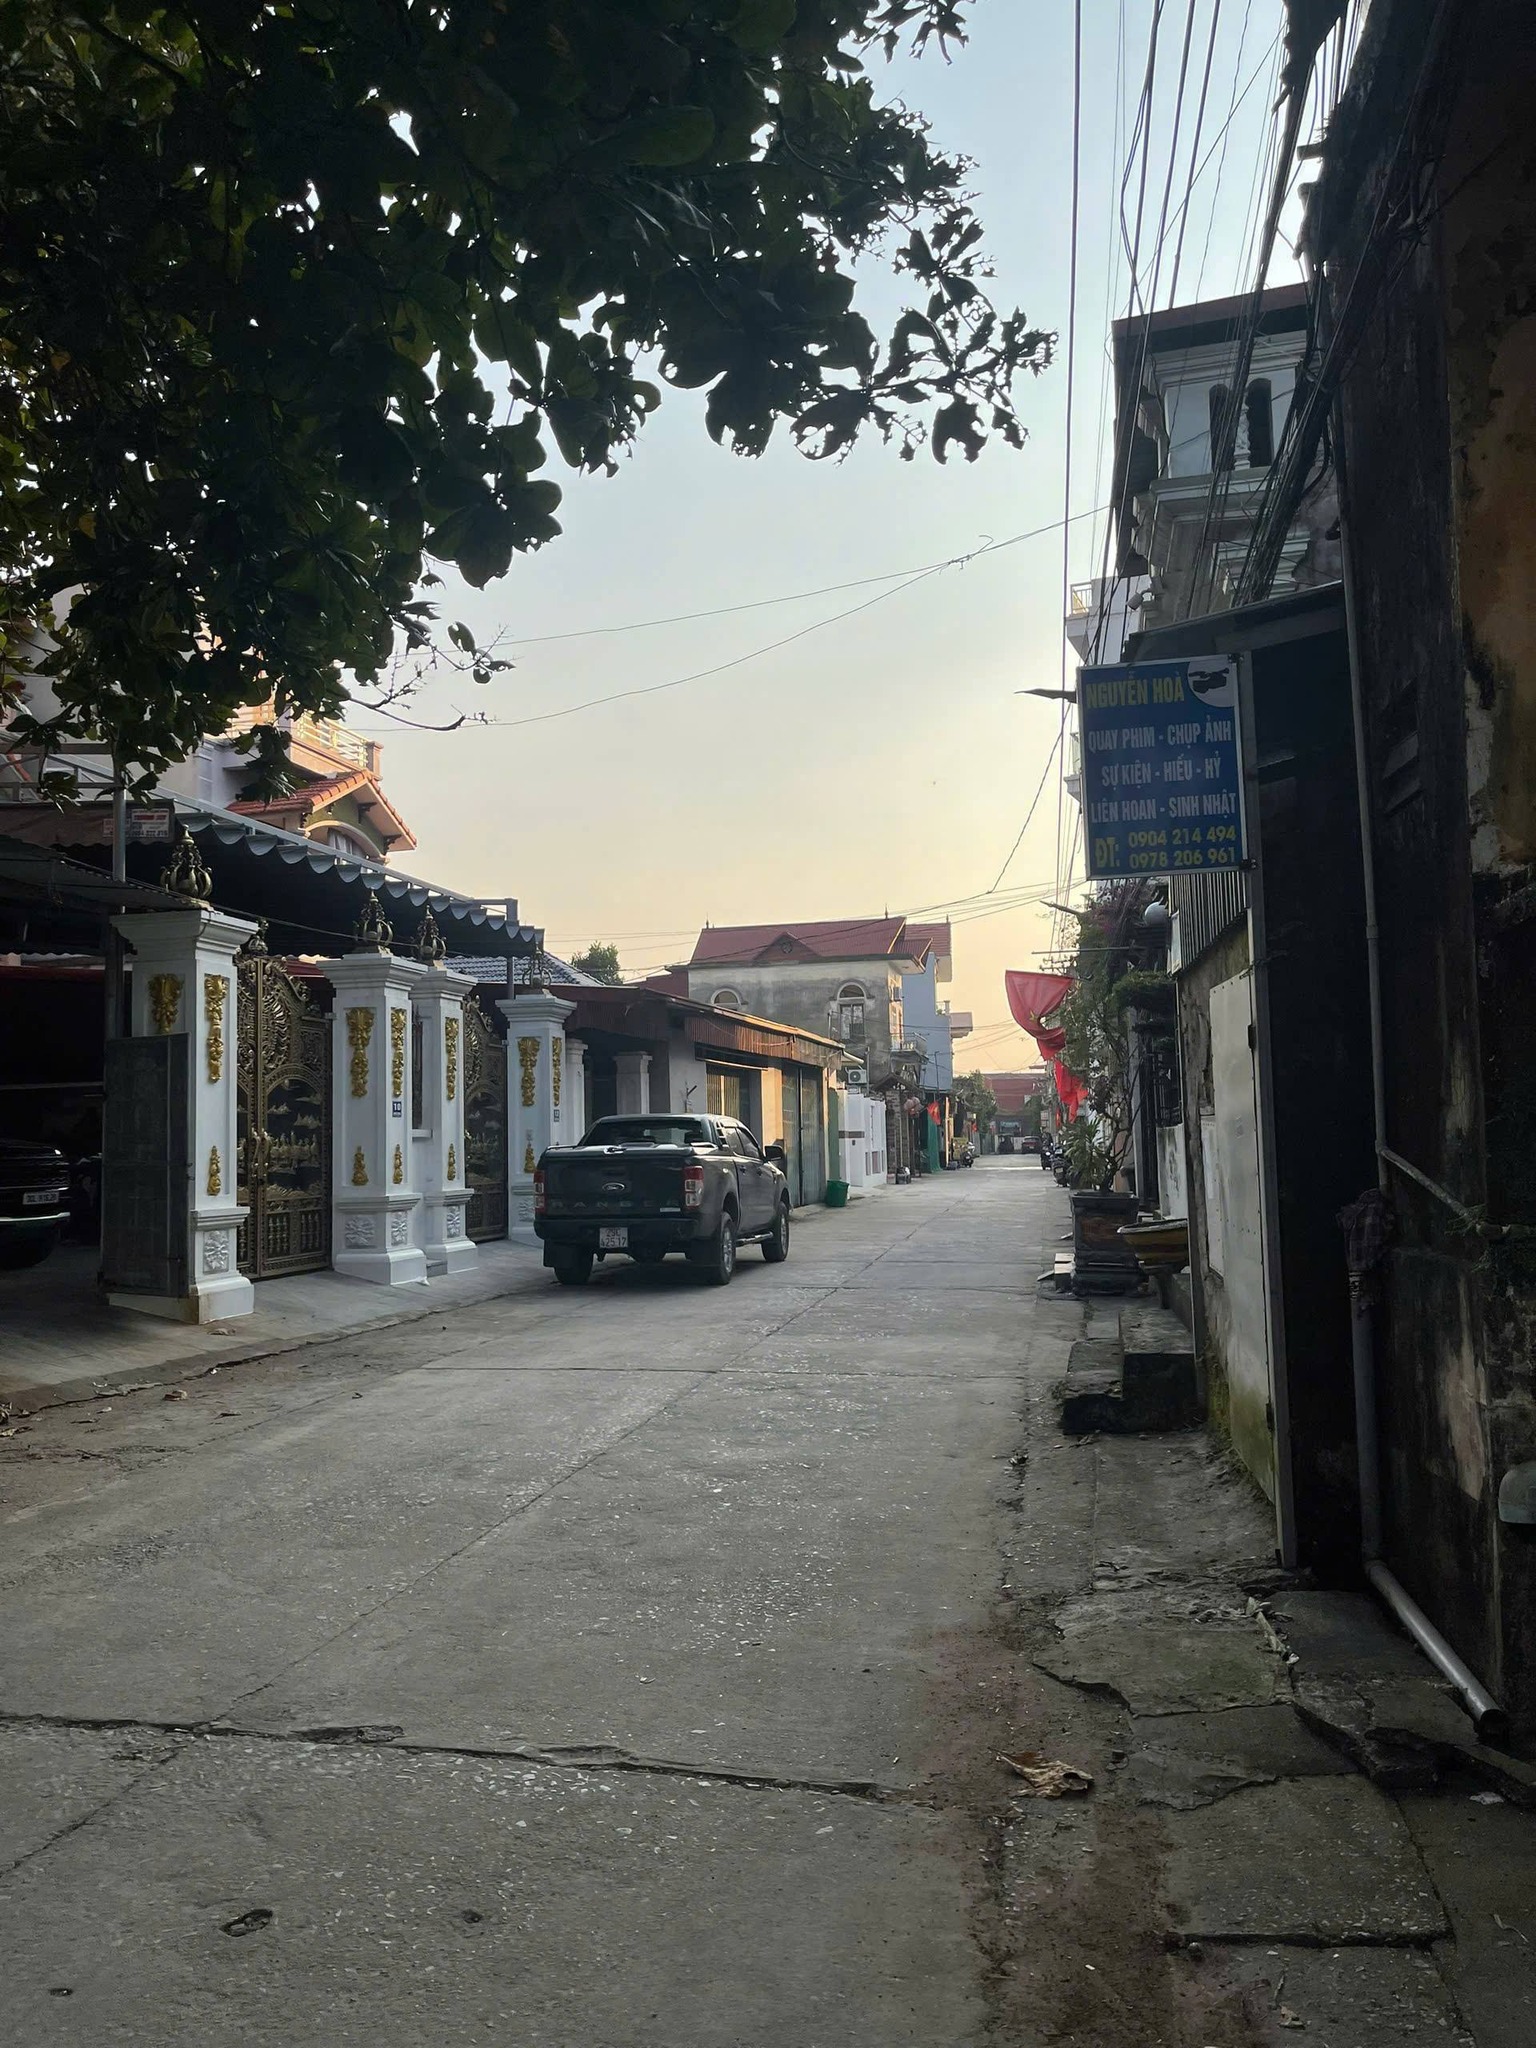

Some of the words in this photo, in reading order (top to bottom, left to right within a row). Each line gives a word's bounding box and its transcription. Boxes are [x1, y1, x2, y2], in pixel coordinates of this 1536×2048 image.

[1086, 670, 1148, 708] NGUYỄN
[1088, 729, 1119, 753] QUAY
[1122, 726, 1154, 748] PHIM
[1167, 723, 1201, 749] CHỤP
[1205, 715, 1231, 743] ẢNH
[1101, 764, 1119, 790] SỰ
[1122, 759, 1151, 789] KIỆN
[1163, 753, 1192, 782] HIẾU
[1205, 750, 1221, 779] HỶ
[1091, 797, 1118, 823] LIÊN
[1122, 799, 1156, 821] HOAN
[1168, 796, 1199, 818] SINH
[1203, 789, 1236, 819] NHẬT
[1095, 837, 1120, 868] ĐT:
[1129, 831, 1167, 848] 0904
[1172, 828, 1201, 844] 214
[1206, 825, 1236, 843] 494
[1129, 851, 1167, 869] 0978
[1174, 849, 1202, 866] 206
[1207, 847, 1235, 864] 961
[551, 1200, 680, 1208] RANGER
